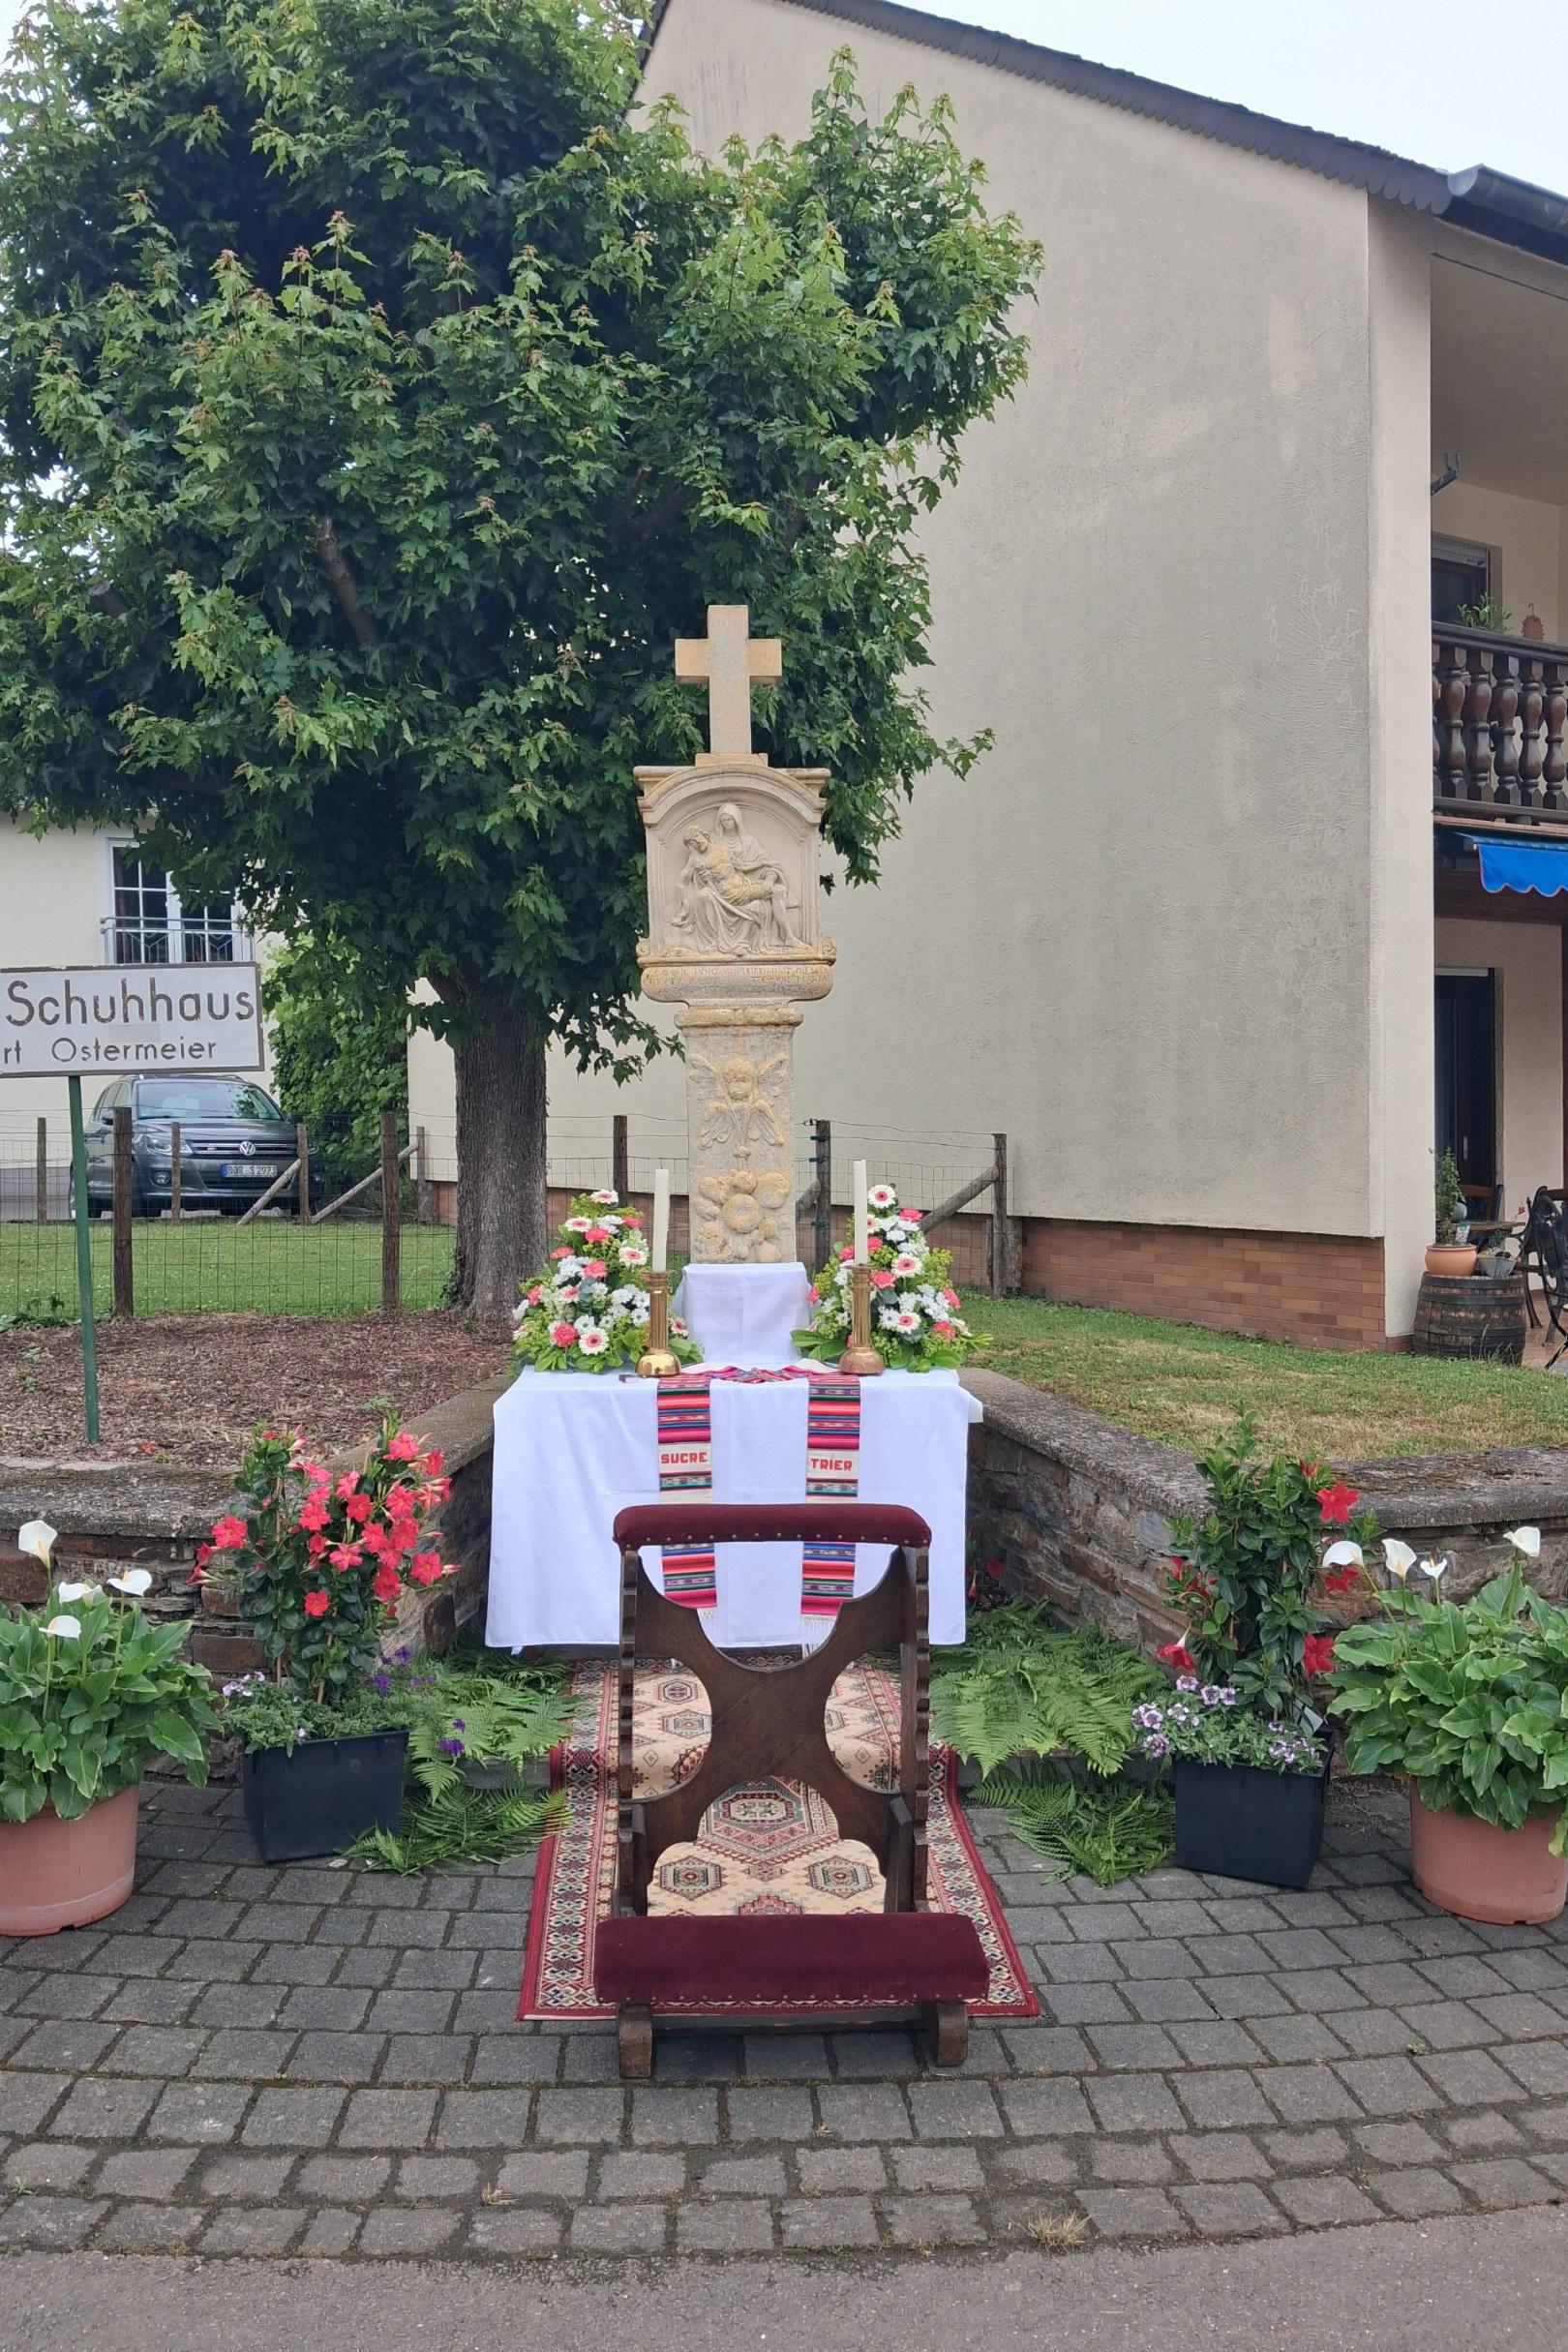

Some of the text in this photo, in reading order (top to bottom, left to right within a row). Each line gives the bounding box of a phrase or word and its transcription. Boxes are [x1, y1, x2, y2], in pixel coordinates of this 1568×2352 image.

[5, 977, 255, 1027] Schuhhaus
[50, 1036, 217, 1063] Ostermeier
[660, 1451, 708, 1464] SUCRE
[810, 1458, 853, 1471] TRIER
